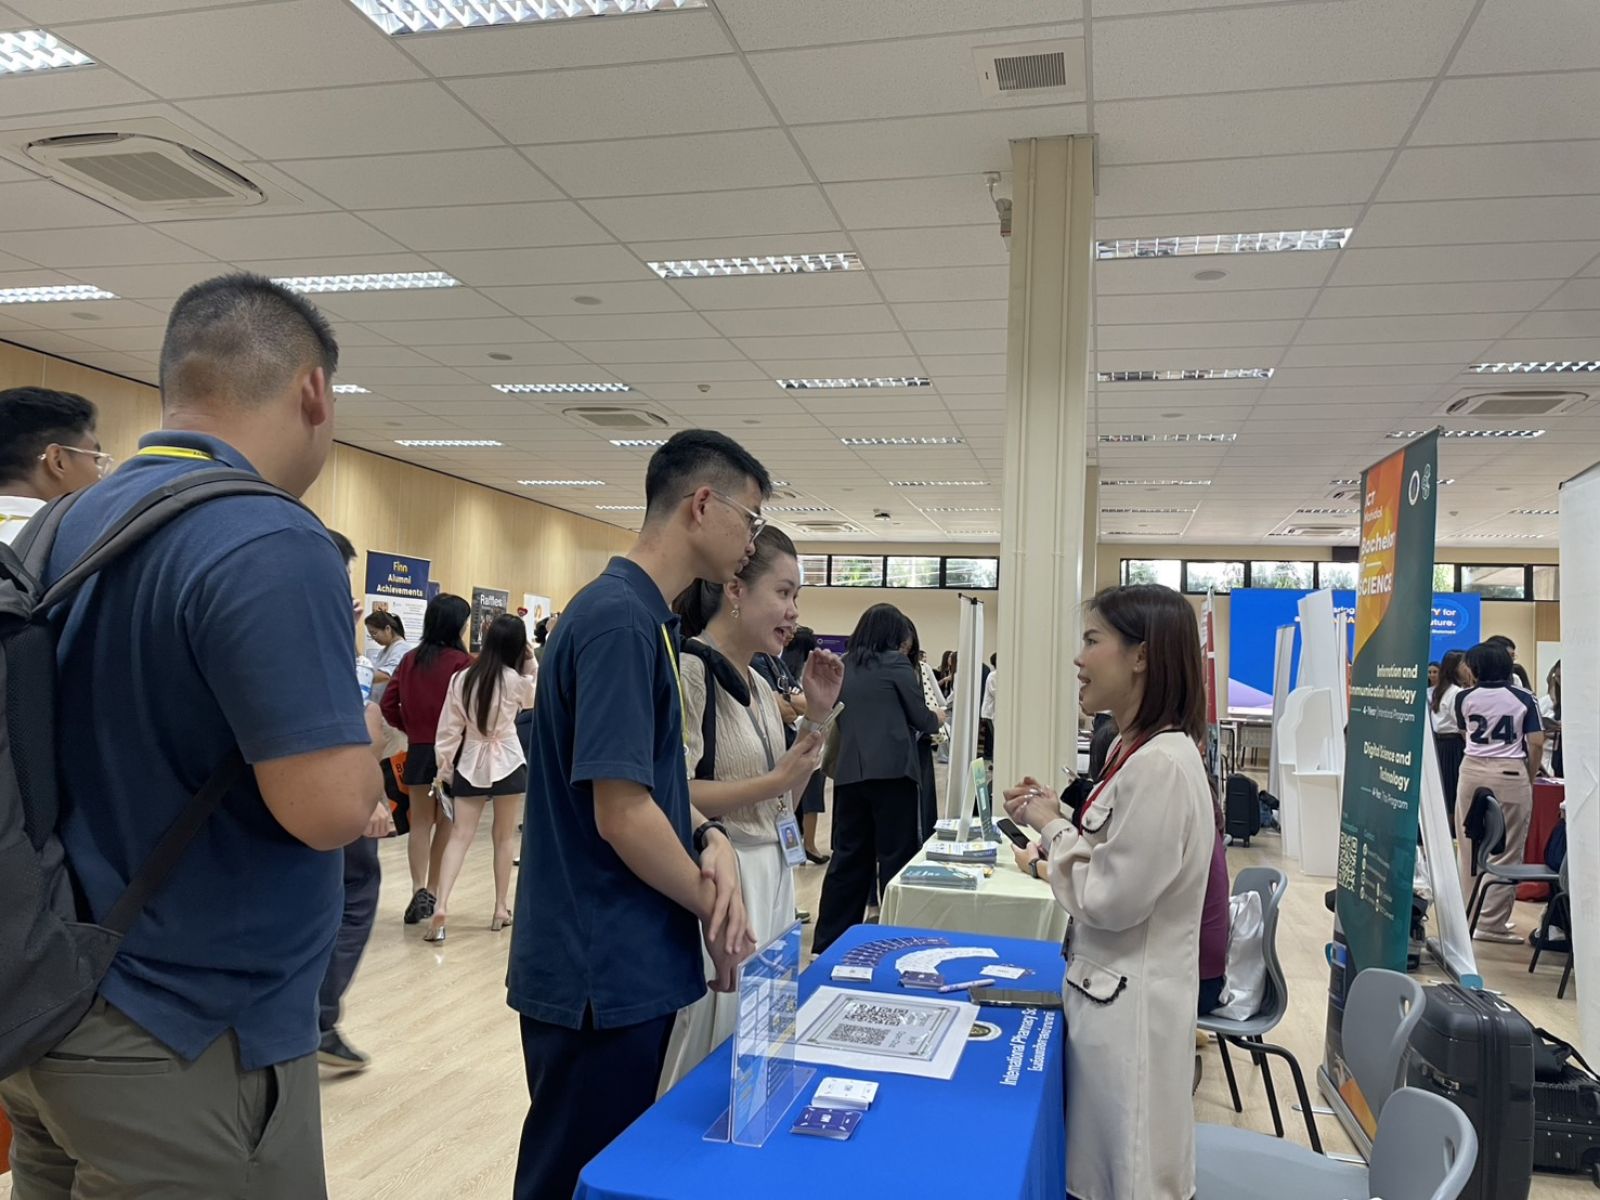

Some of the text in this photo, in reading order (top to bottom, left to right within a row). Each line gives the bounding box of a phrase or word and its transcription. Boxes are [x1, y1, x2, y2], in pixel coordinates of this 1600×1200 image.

[393, 561, 408, 573] Finn
[388, 573, 412, 585] Alumni
[376, 584, 423, 597] Achievements
[1442, 608, 1457, 616] for
[1402, 664, 1418, 679] and
[1469, 714, 1517, 745] 24
[1395, 751, 1412, 766] and
[1010, 1014, 1039, 1045] Pharmacy
[999, 1042, 1025, 1086] International
